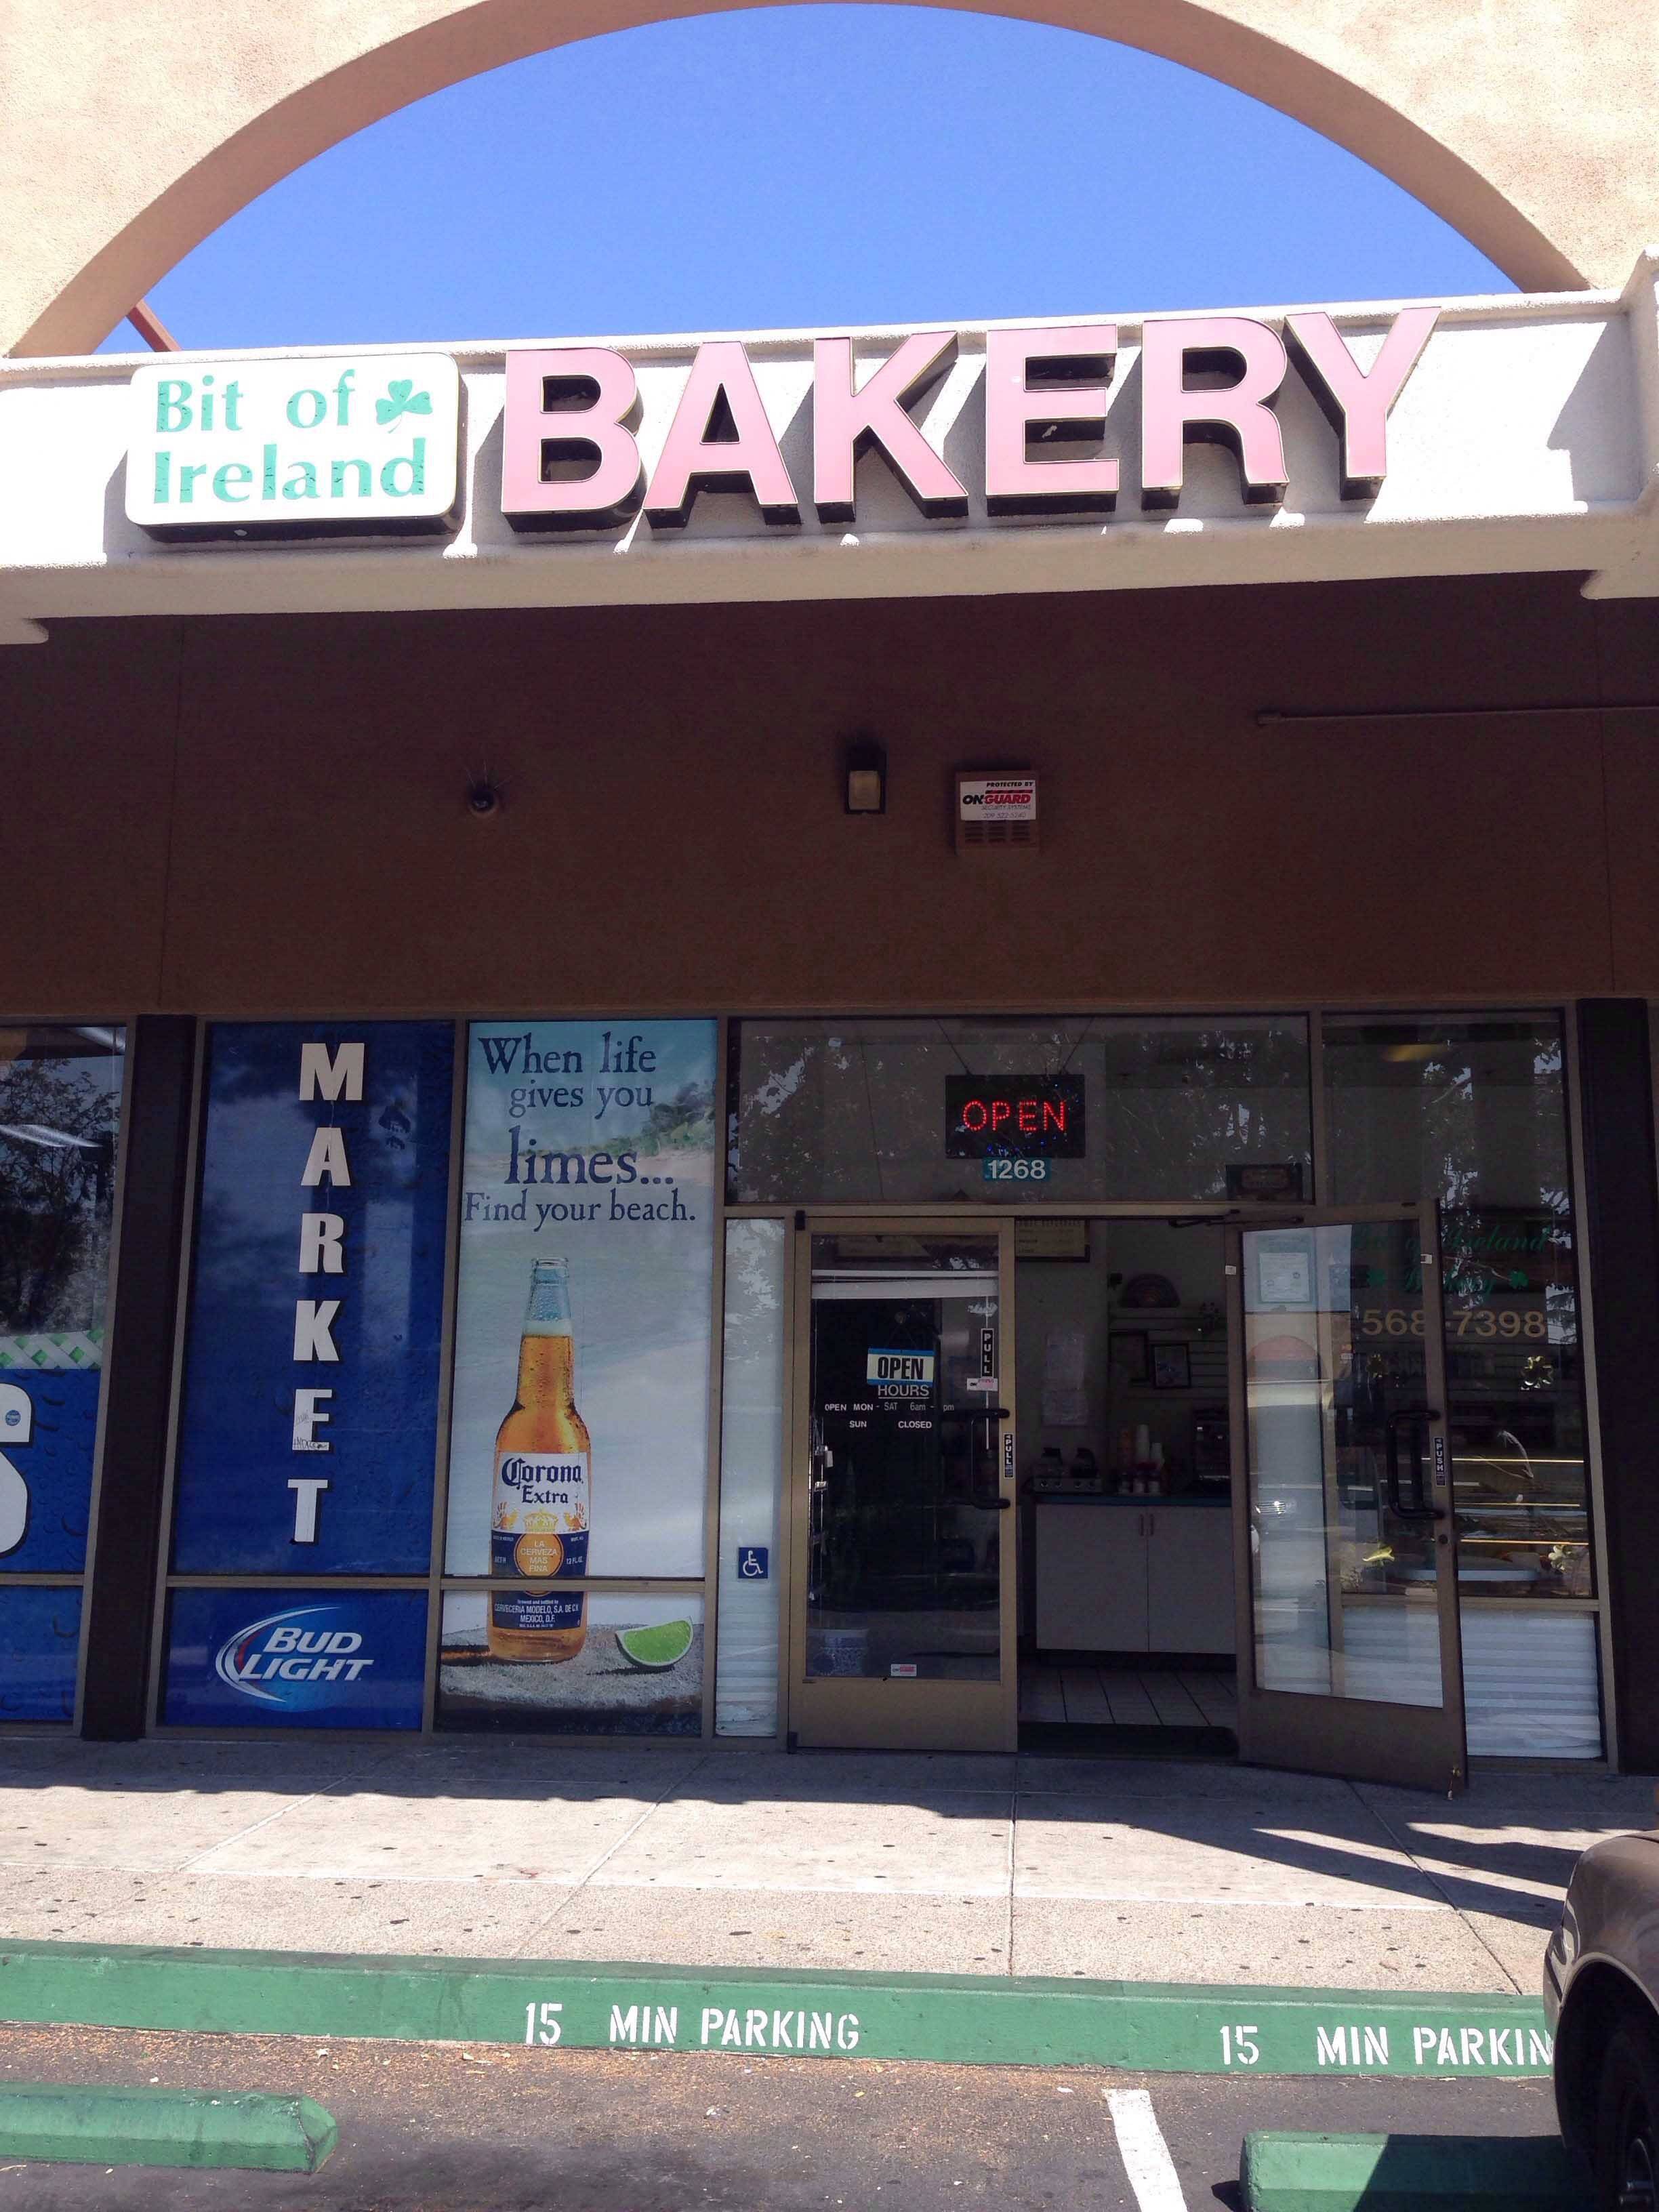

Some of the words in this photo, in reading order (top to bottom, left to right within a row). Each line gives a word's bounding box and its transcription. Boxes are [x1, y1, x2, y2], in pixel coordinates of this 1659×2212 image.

[156, 375, 243, 433] Bit
[285, 369, 356, 428] of
[500, 306, 1443, 515] BAKERY
[153, 438, 426, 504] Ireland
[478, 1032, 583, 1074] When
[599, 1031, 656, 1073] life
[509, 1080, 583, 1118] gives
[594, 1086, 654, 1120] you
[962, 1099, 1067, 1132] OPEN
[504, 1125, 674, 1185] limes...
[987, 1160, 1046, 1179] 1268
[464, 1188, 527, 1221] Find
[533, 1202, 602, 1232] your
[609, 1188, 696, 1221] beach.
[287, 1042, 365, 1542] MARKET
[877, 1357, 924, 1380] OPEN
[983, 1332, 992, 1374] PULL
[824, 1403, 847, 1411] OPEN
[884, 1401, 899, 1410] SAT
[909, 1401, 926, 1411] 6am
[943, 1404, 955, 1412] pm
[878, 1385, 930, 1396] HOURS
[849, 1420, 867, 1428] SUN
[898, 1420, 933, 1429] CLOSED
[1436, 1443, 1444, 1471] PUSH
[501, 1458, 581, 1490] Corona
[522, 1485, 569, 1503] Extra
[520, 1548, 558, 1556] CERVEZA
[520, 1614, 545, 1623] MEXICO,
[263, 1626, 363, 1654] BUD
[239, 1654, 375, 1681] LIGHT
[525, 2001, 563, 2046] 15
[609, 2004, 678, 2044] MIN
[700, 2007, 860, 2050] PARKING
[1219, 2025, 1259, 2066] 15
[1317, 2026, 1389, 2066] MIN
[1412, 2026, 1555, 2066] PARKIN
